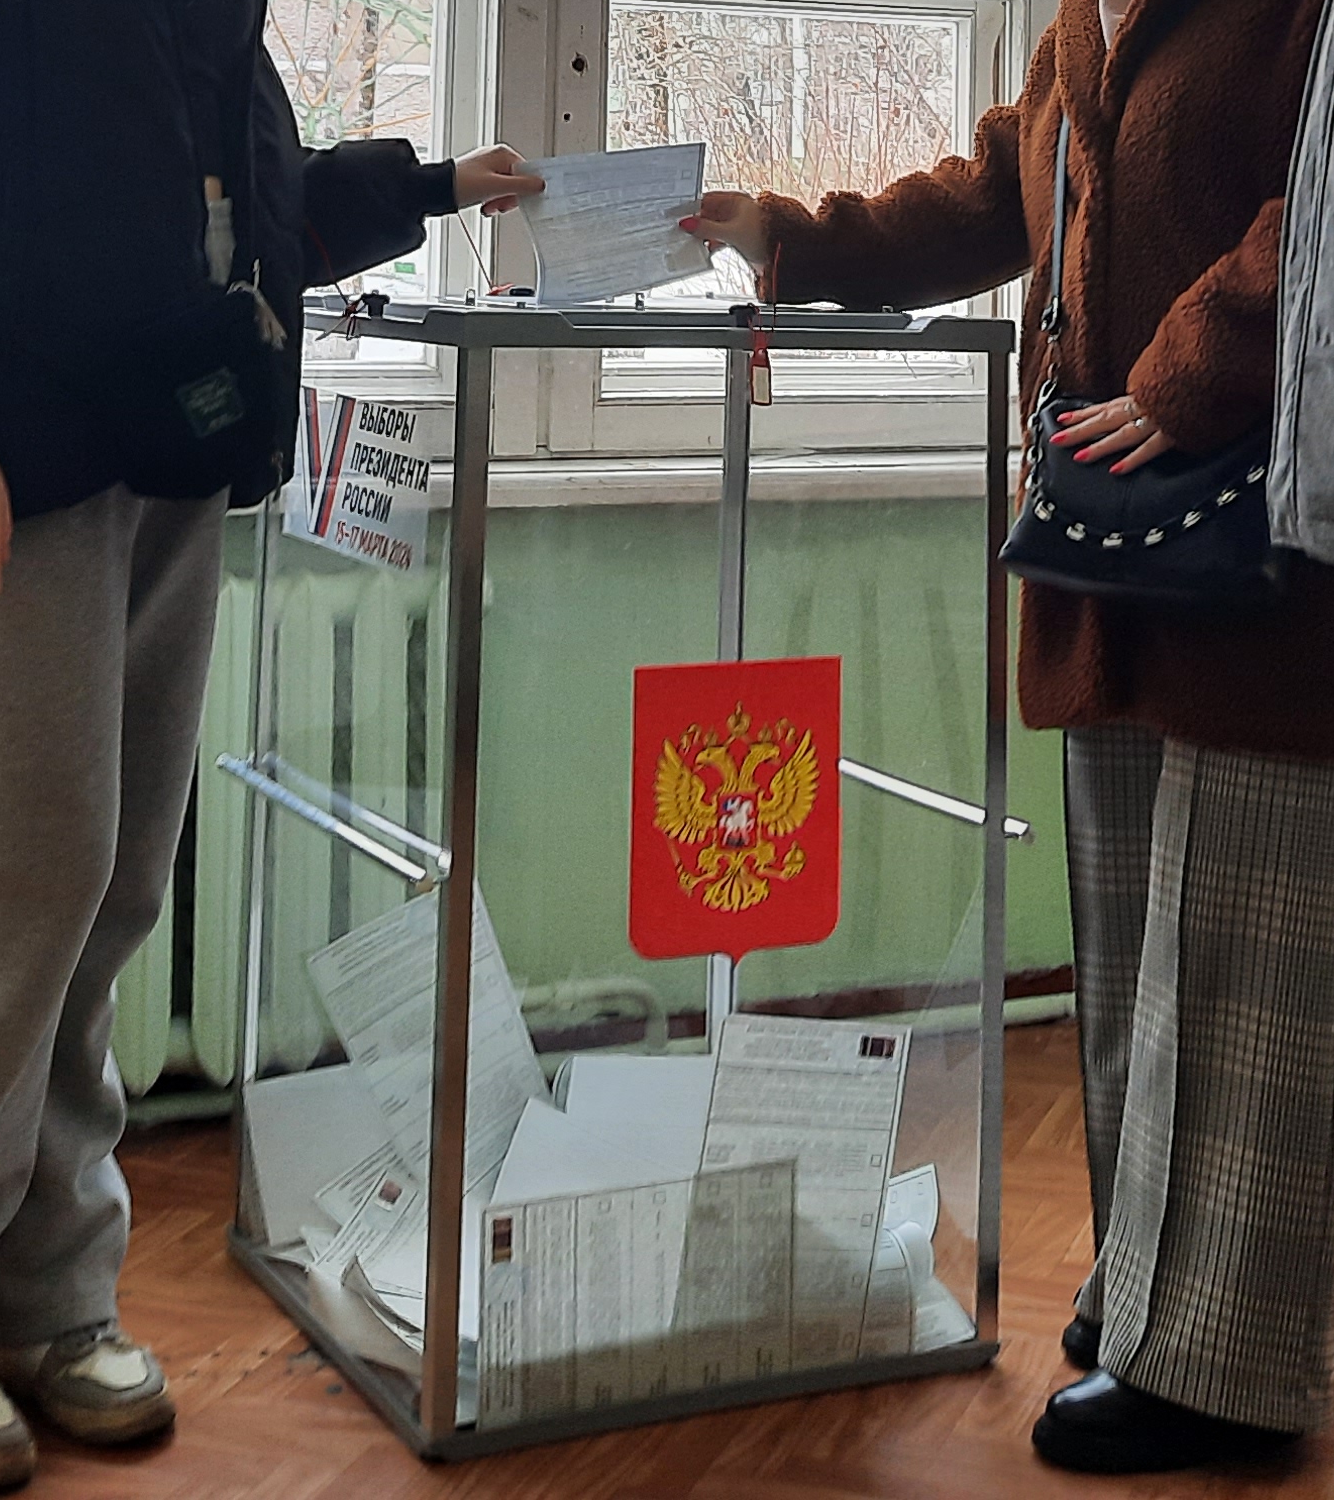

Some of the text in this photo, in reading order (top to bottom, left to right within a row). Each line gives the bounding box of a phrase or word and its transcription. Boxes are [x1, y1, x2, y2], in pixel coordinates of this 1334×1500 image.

[359, 402, 417, 444] ВЫБОРЫ
[350, 443, 431, 493] ПРЕЗИДЕНТА
[341, 482, 394, 524] РОССИИ
